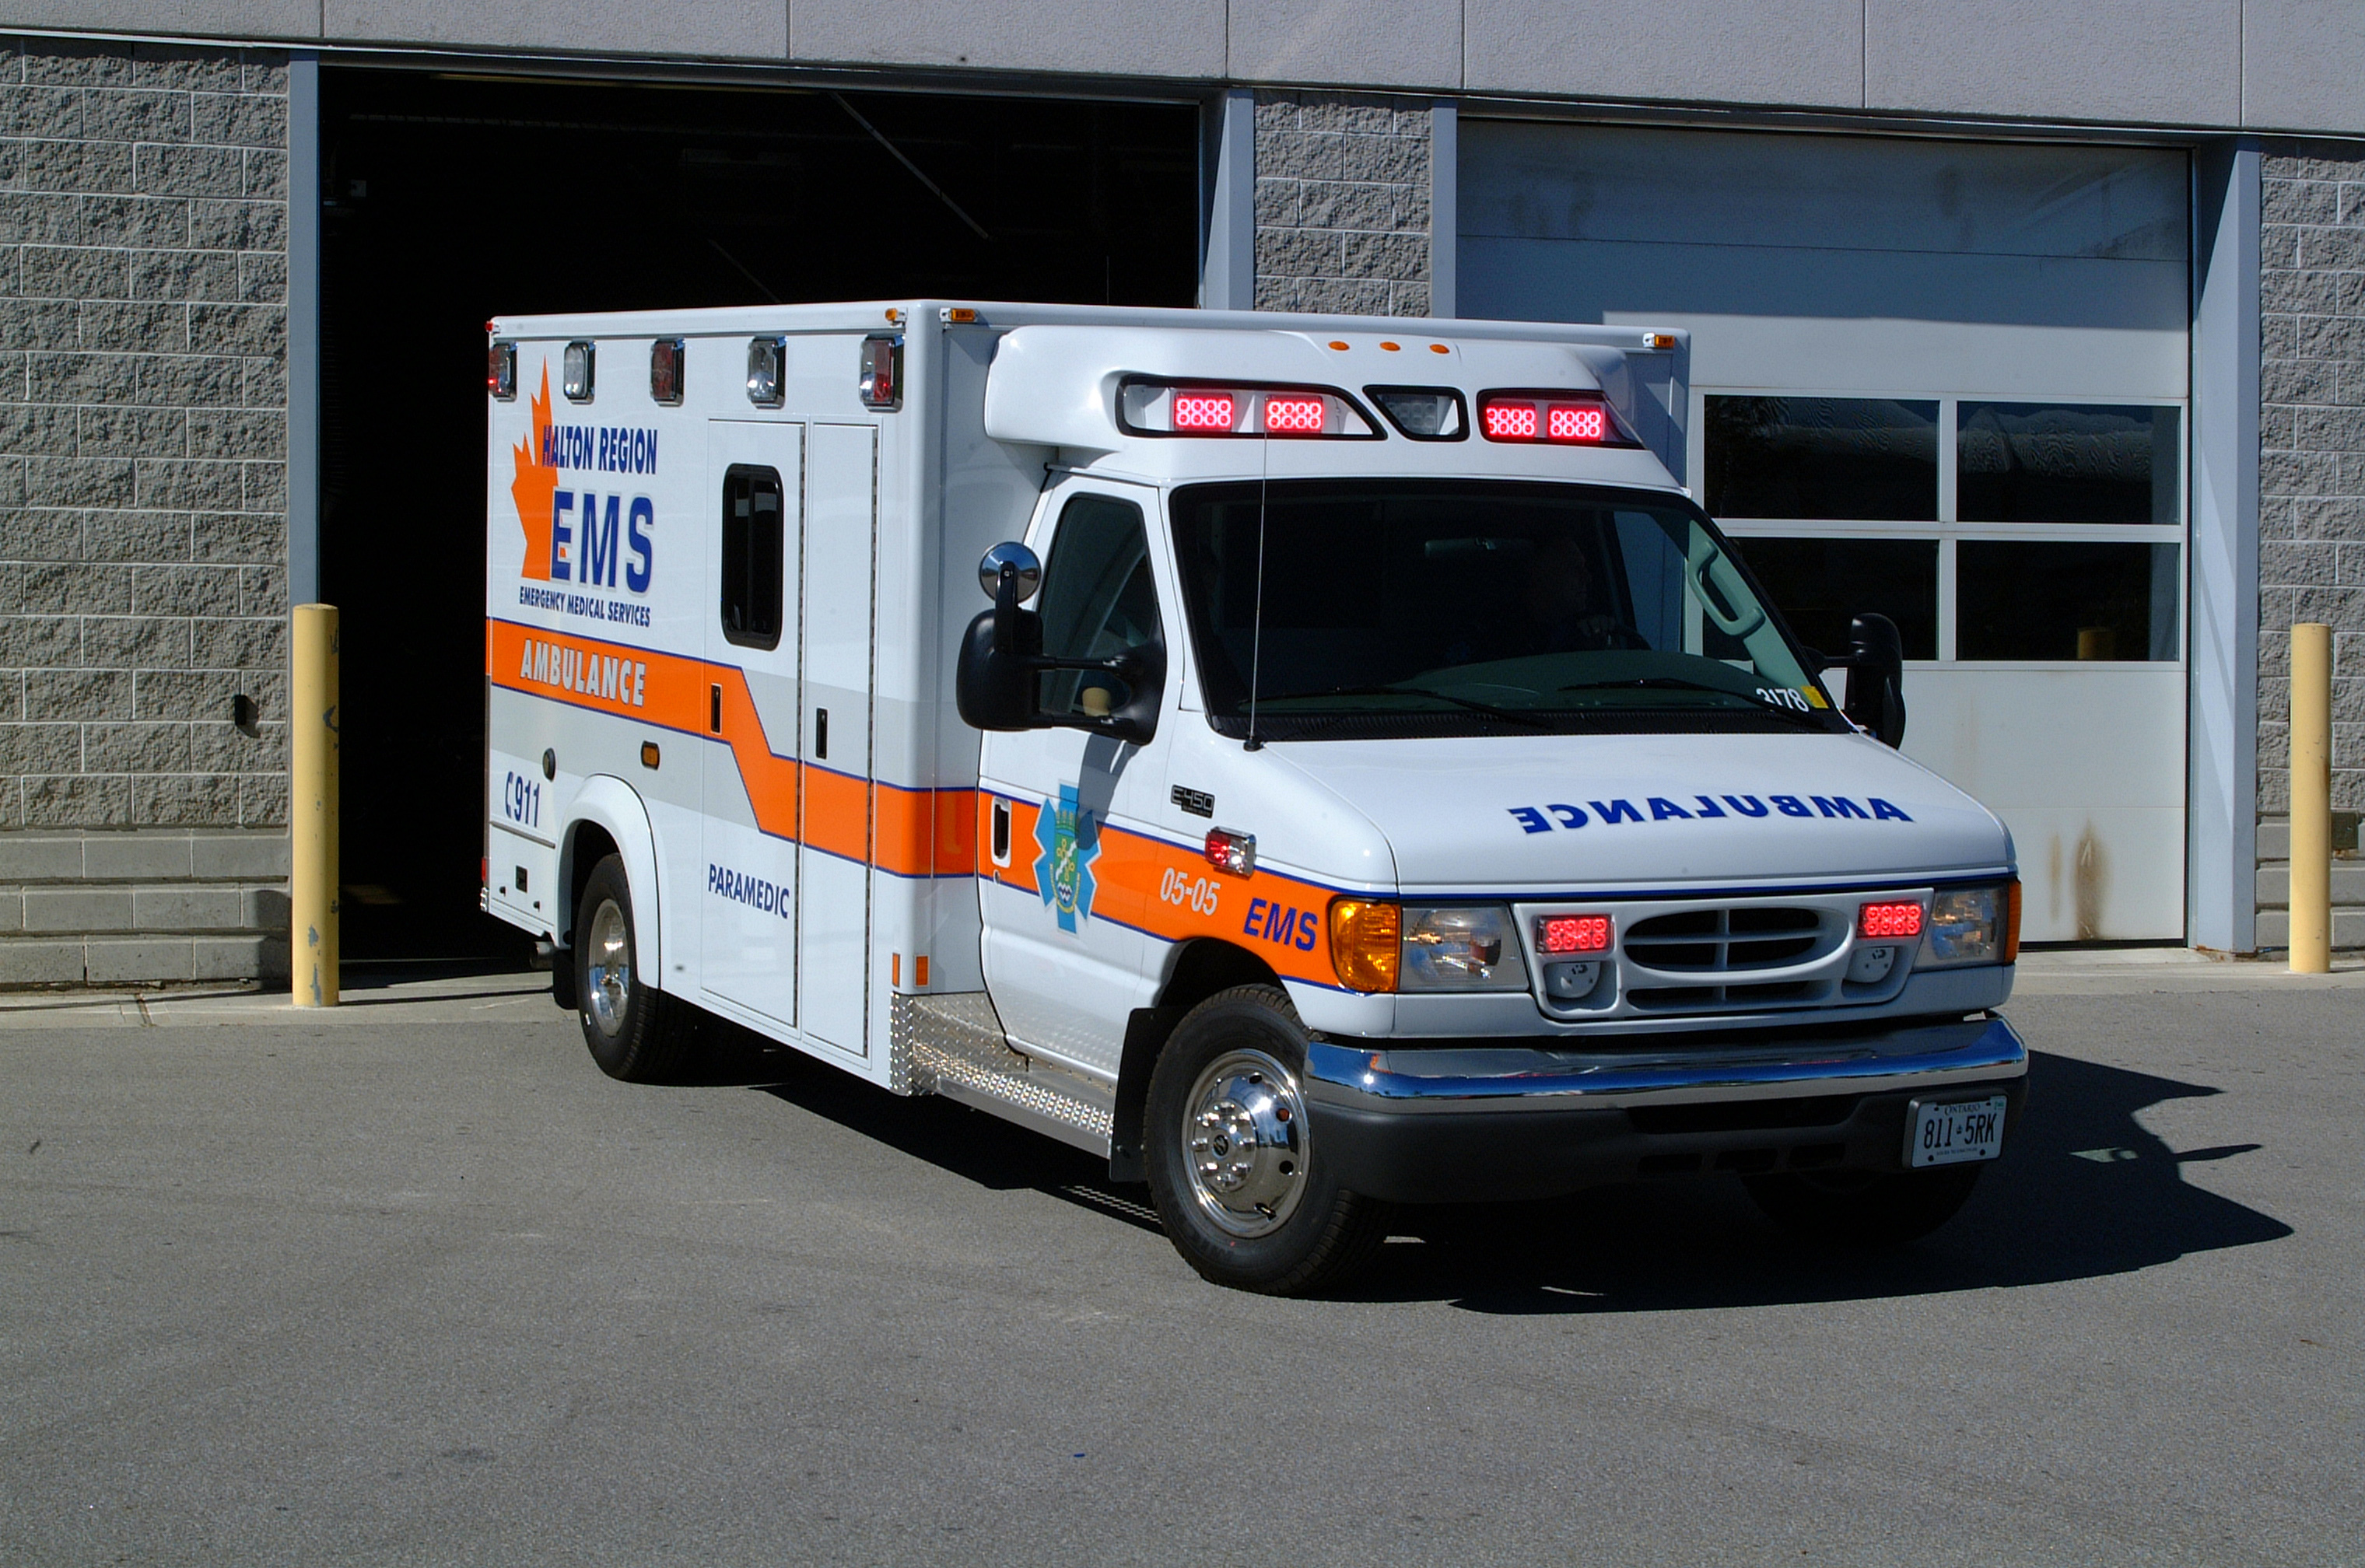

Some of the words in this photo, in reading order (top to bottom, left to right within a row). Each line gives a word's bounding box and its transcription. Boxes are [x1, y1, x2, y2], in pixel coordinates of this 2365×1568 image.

[542, 425, 594, 471] HALTON
[597, 427, 658, 474] REGION
[551, 490, 654, 593] EMS
[519, 586, 566, 613] EMERGENCY
[566, 593, 604, 620] MEDICAL
[607, 600, 650, 628] SERVICES
[519, 638, 646, 707] AMBULANCE
[514, 775, 541, 828] 911
[708, 863, 790, 919] PARAMEDIC
[1159, 866, 1221, 916] 05-05
[1243, 897, 1319, 952] EMS
